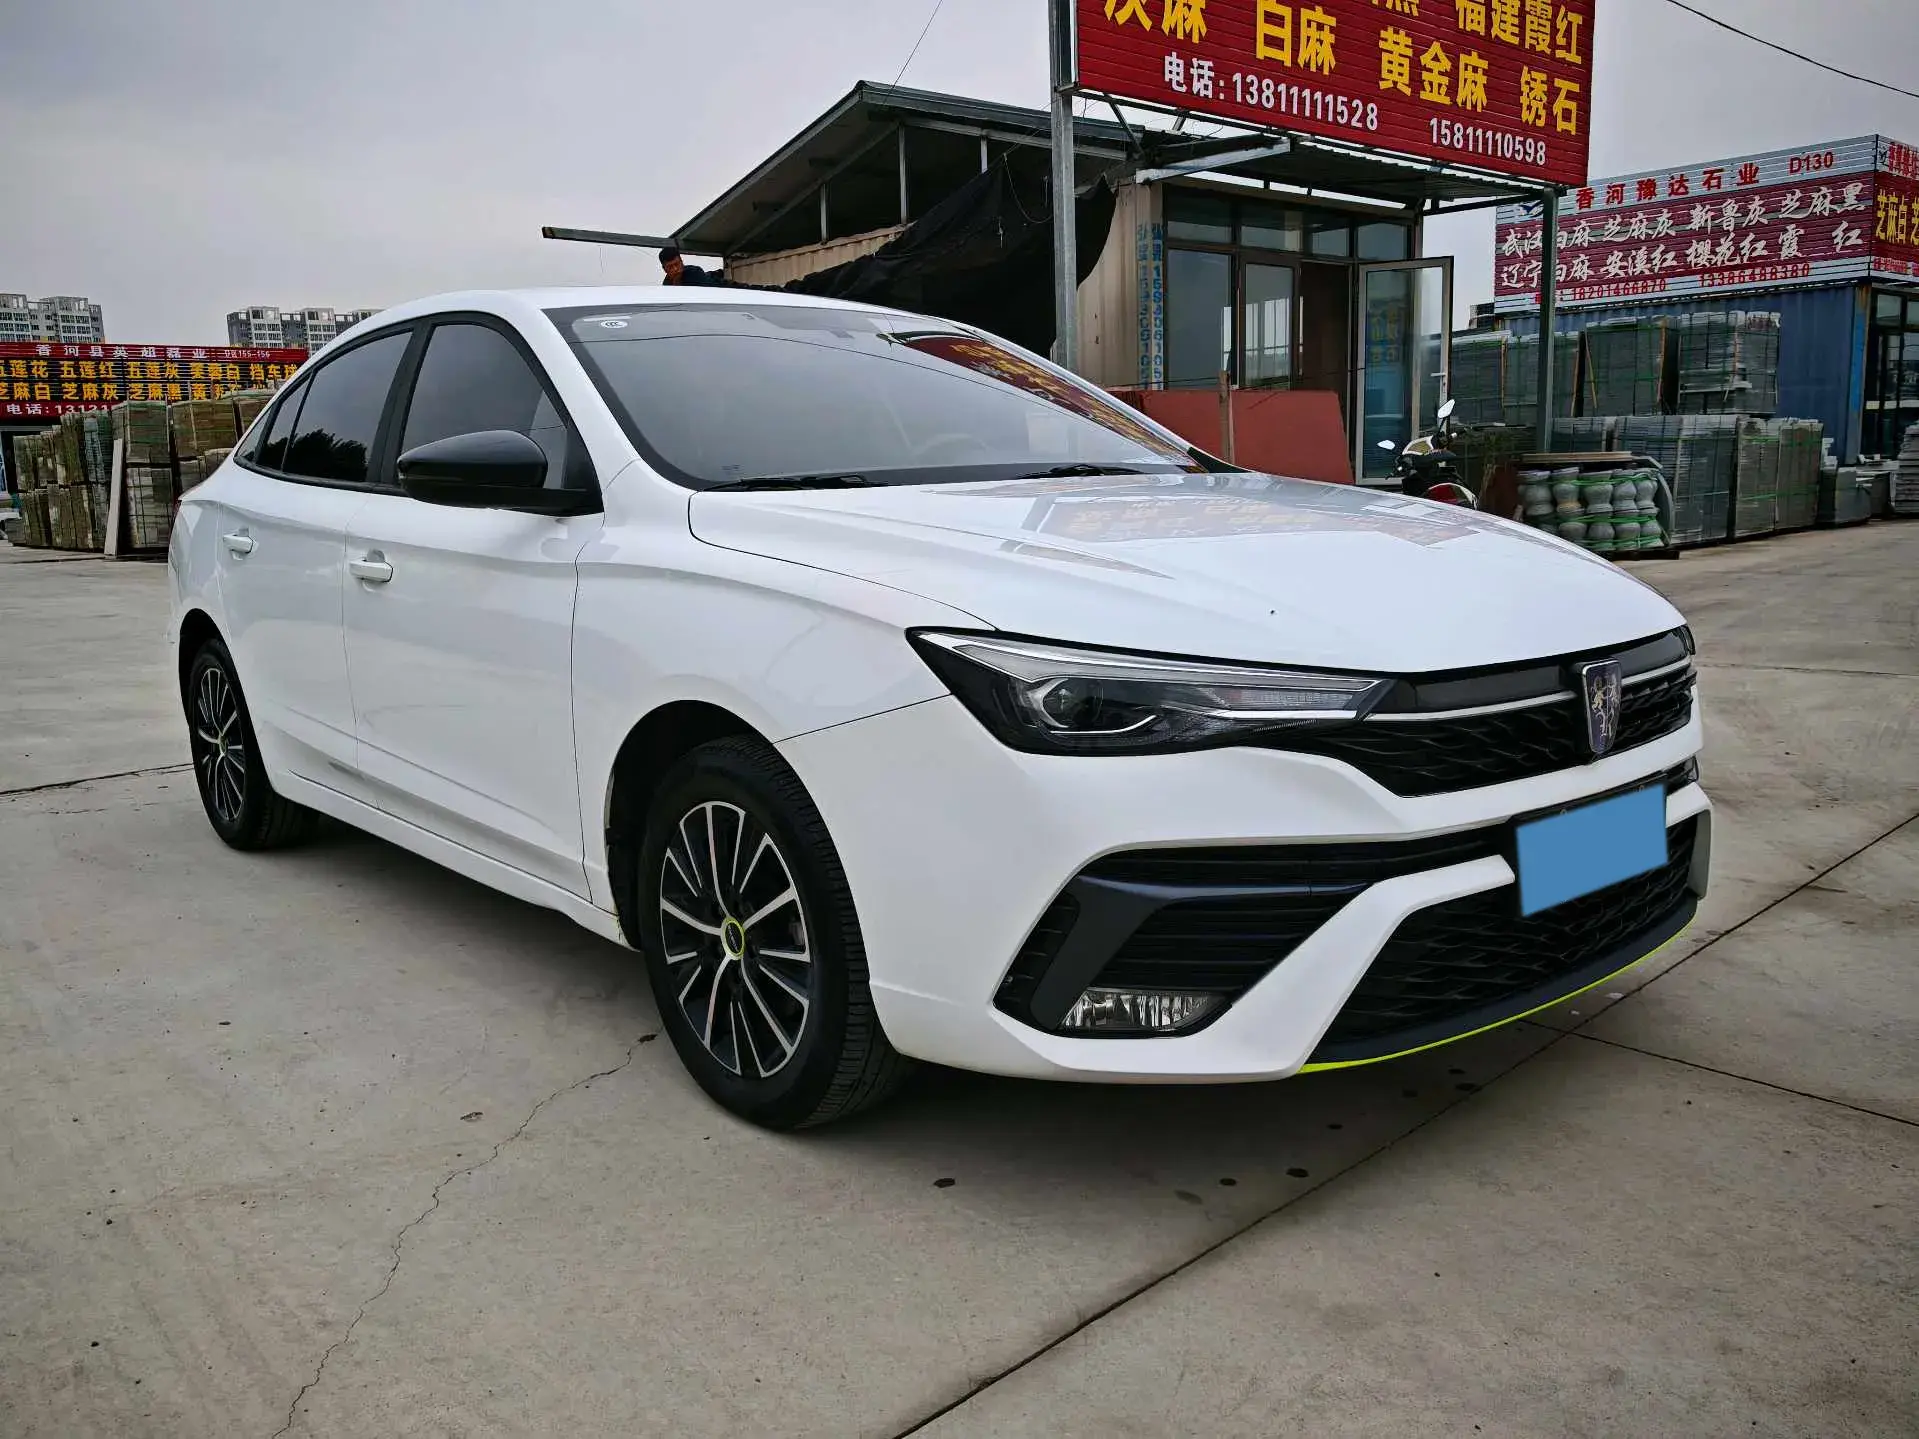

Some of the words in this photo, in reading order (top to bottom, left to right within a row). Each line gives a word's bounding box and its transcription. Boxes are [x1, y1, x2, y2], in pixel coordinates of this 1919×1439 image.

[1455, 0, 1583, 64] 福建霞红
[1256, 0, 1337, 75] 白麻
[1379, 25, 1489, 113] 黄金麻
[1519, 65, 1581, 135] 锈石
[1429, 117, 1546, 166] 15811110598
[1789, 151, 1834, 175] D130
[1601, 208, 1677, 243] 芝麻灰
[1778, 182, 1867, 219] 芝麻黑
[1876, 188, 1908, 245] 芝麻白
[60, 360, 114, 378] 五莲红
[61, 382, 119, 400] 芝麻灰
[128, 382, 182, 400] 芝麻黑
